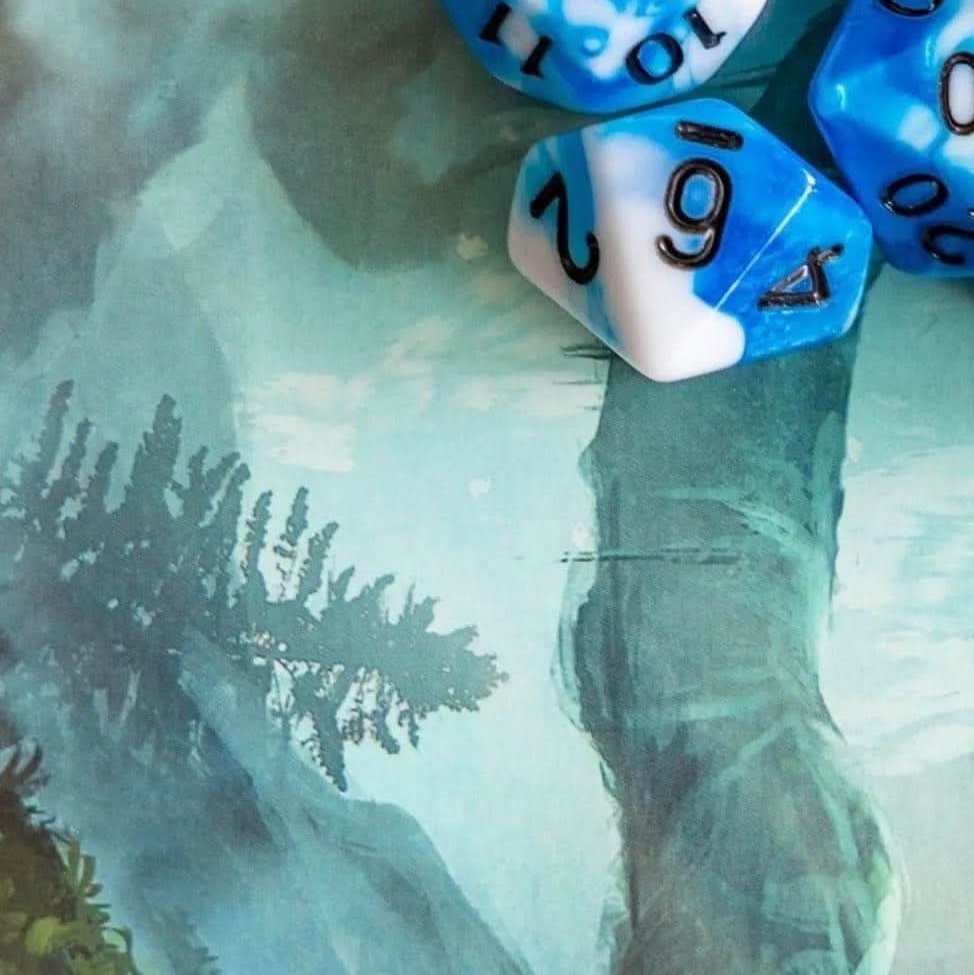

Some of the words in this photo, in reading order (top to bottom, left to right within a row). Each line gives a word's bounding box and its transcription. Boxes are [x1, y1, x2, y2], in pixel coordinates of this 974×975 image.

[479, 1, 552, 78] 11
[625, 6, 728, 86] 10
[529, 171, 601, 286] 2
[756, 243, 846, 312] 4
